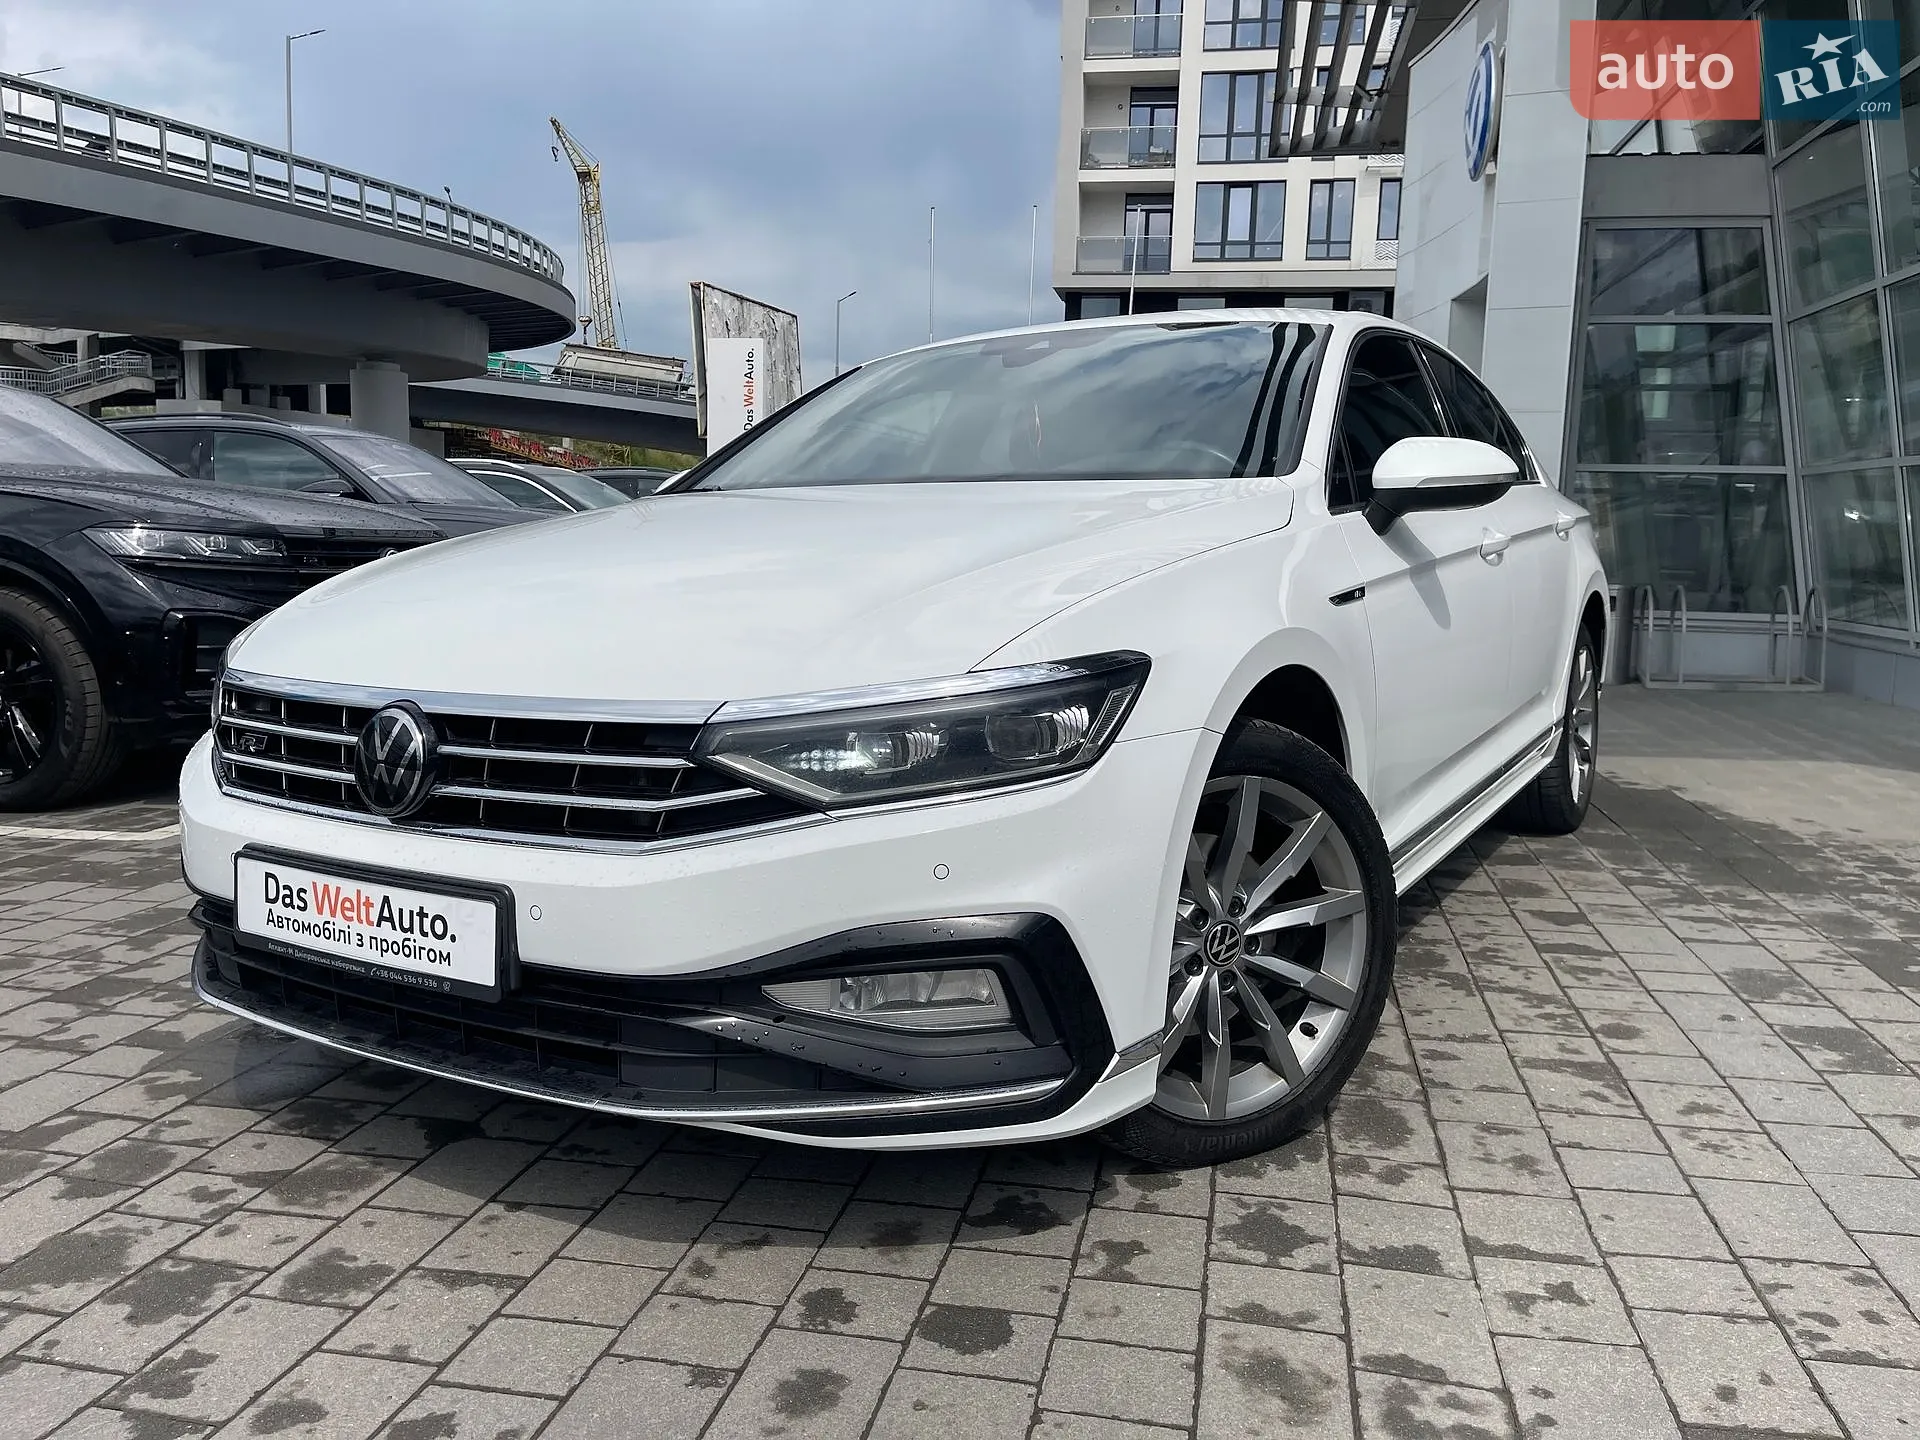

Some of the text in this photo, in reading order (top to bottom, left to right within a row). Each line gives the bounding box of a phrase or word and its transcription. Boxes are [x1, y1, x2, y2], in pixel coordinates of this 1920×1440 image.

[743, 348, 755, 431] Das WeltAuto.
[264, 871, 457, 944] Das WeltAuto.
[266, 908, 452, 967] Автомобілі з пробігом
